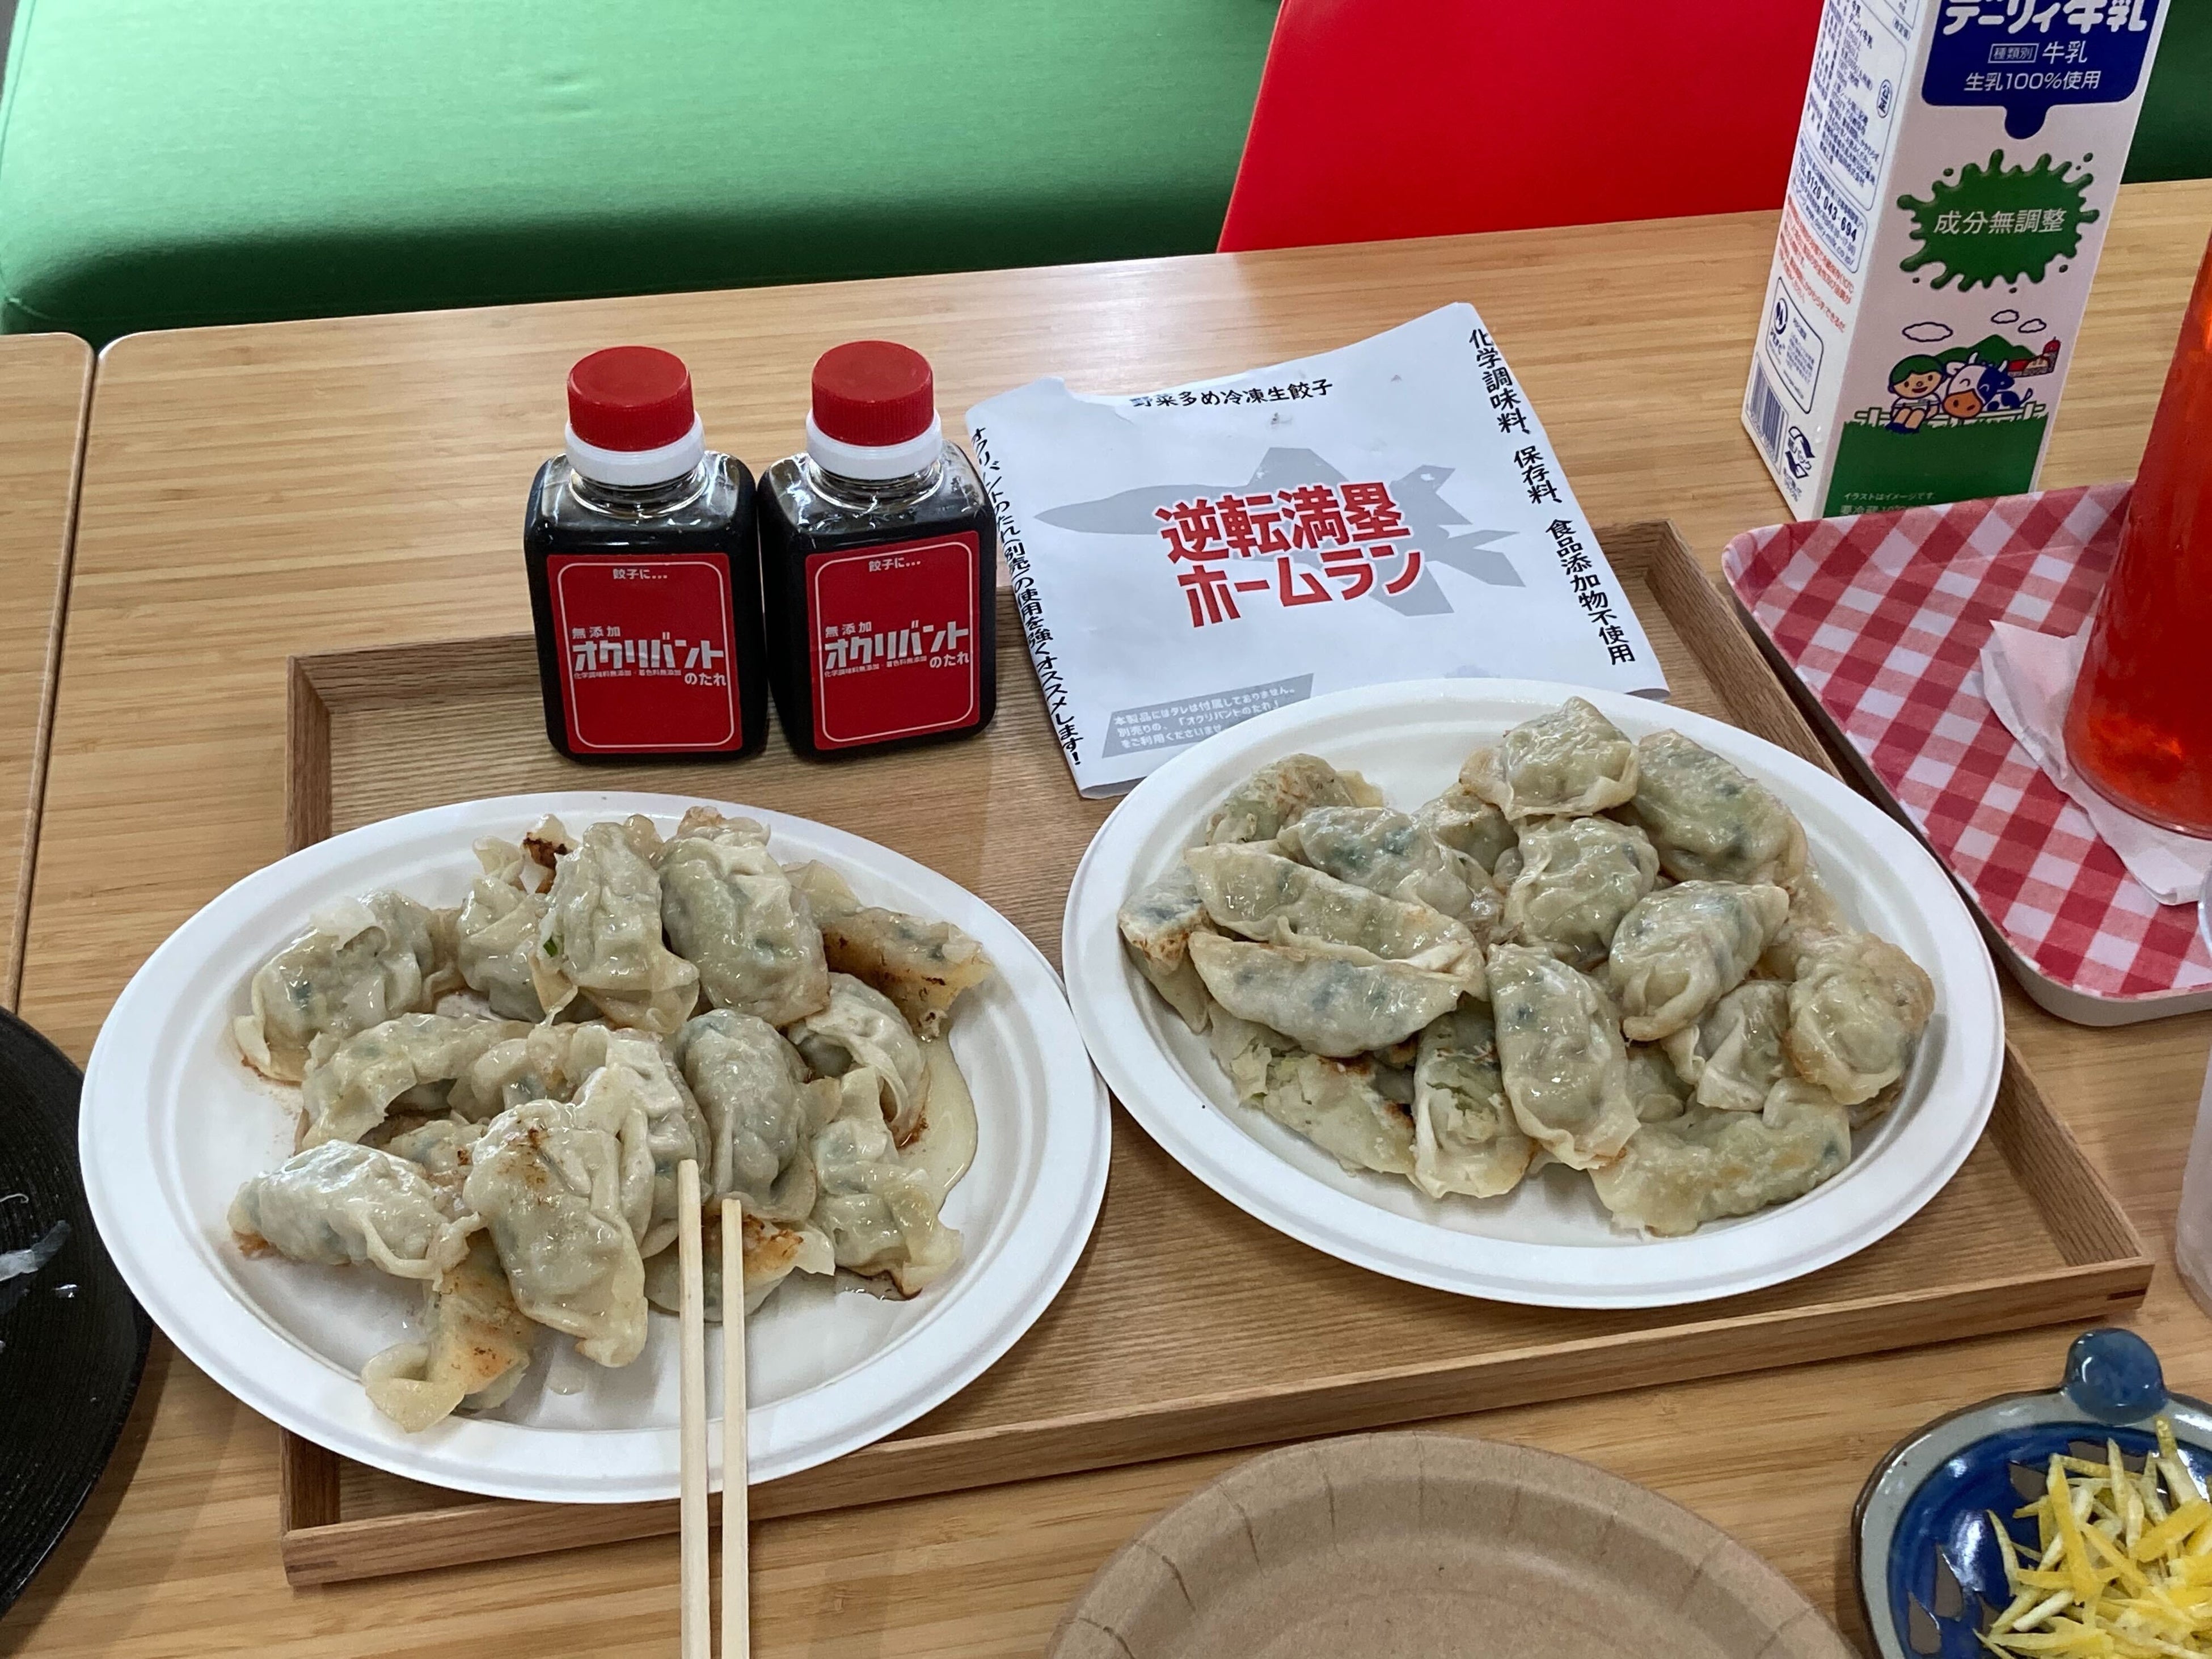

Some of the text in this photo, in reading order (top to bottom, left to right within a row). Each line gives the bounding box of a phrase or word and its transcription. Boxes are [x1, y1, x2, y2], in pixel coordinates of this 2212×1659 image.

[1993, 40, 2087, 64] 種類別 牛乳
[1964, 70, 2101, 91] 生乳100%使用
[1934, 207, 2067, 234] 成分無調整
[1155, 482, 1411, 564] 逆転満塁
[1177, 544, 1421, 628] ホームラン
[572, 626, 621, 640] 無添加
[825, 621, 872, 638] 無添加
[572, 631, 724, 672] オクリバント
[825, 619, 969, 670] オクリバント
[930, 651, 970, 669] のたれ
[684, 672, 727, 686] のたれ
[1113, 686, 1295, 725] 本製品にはタレは付属しておりません。
